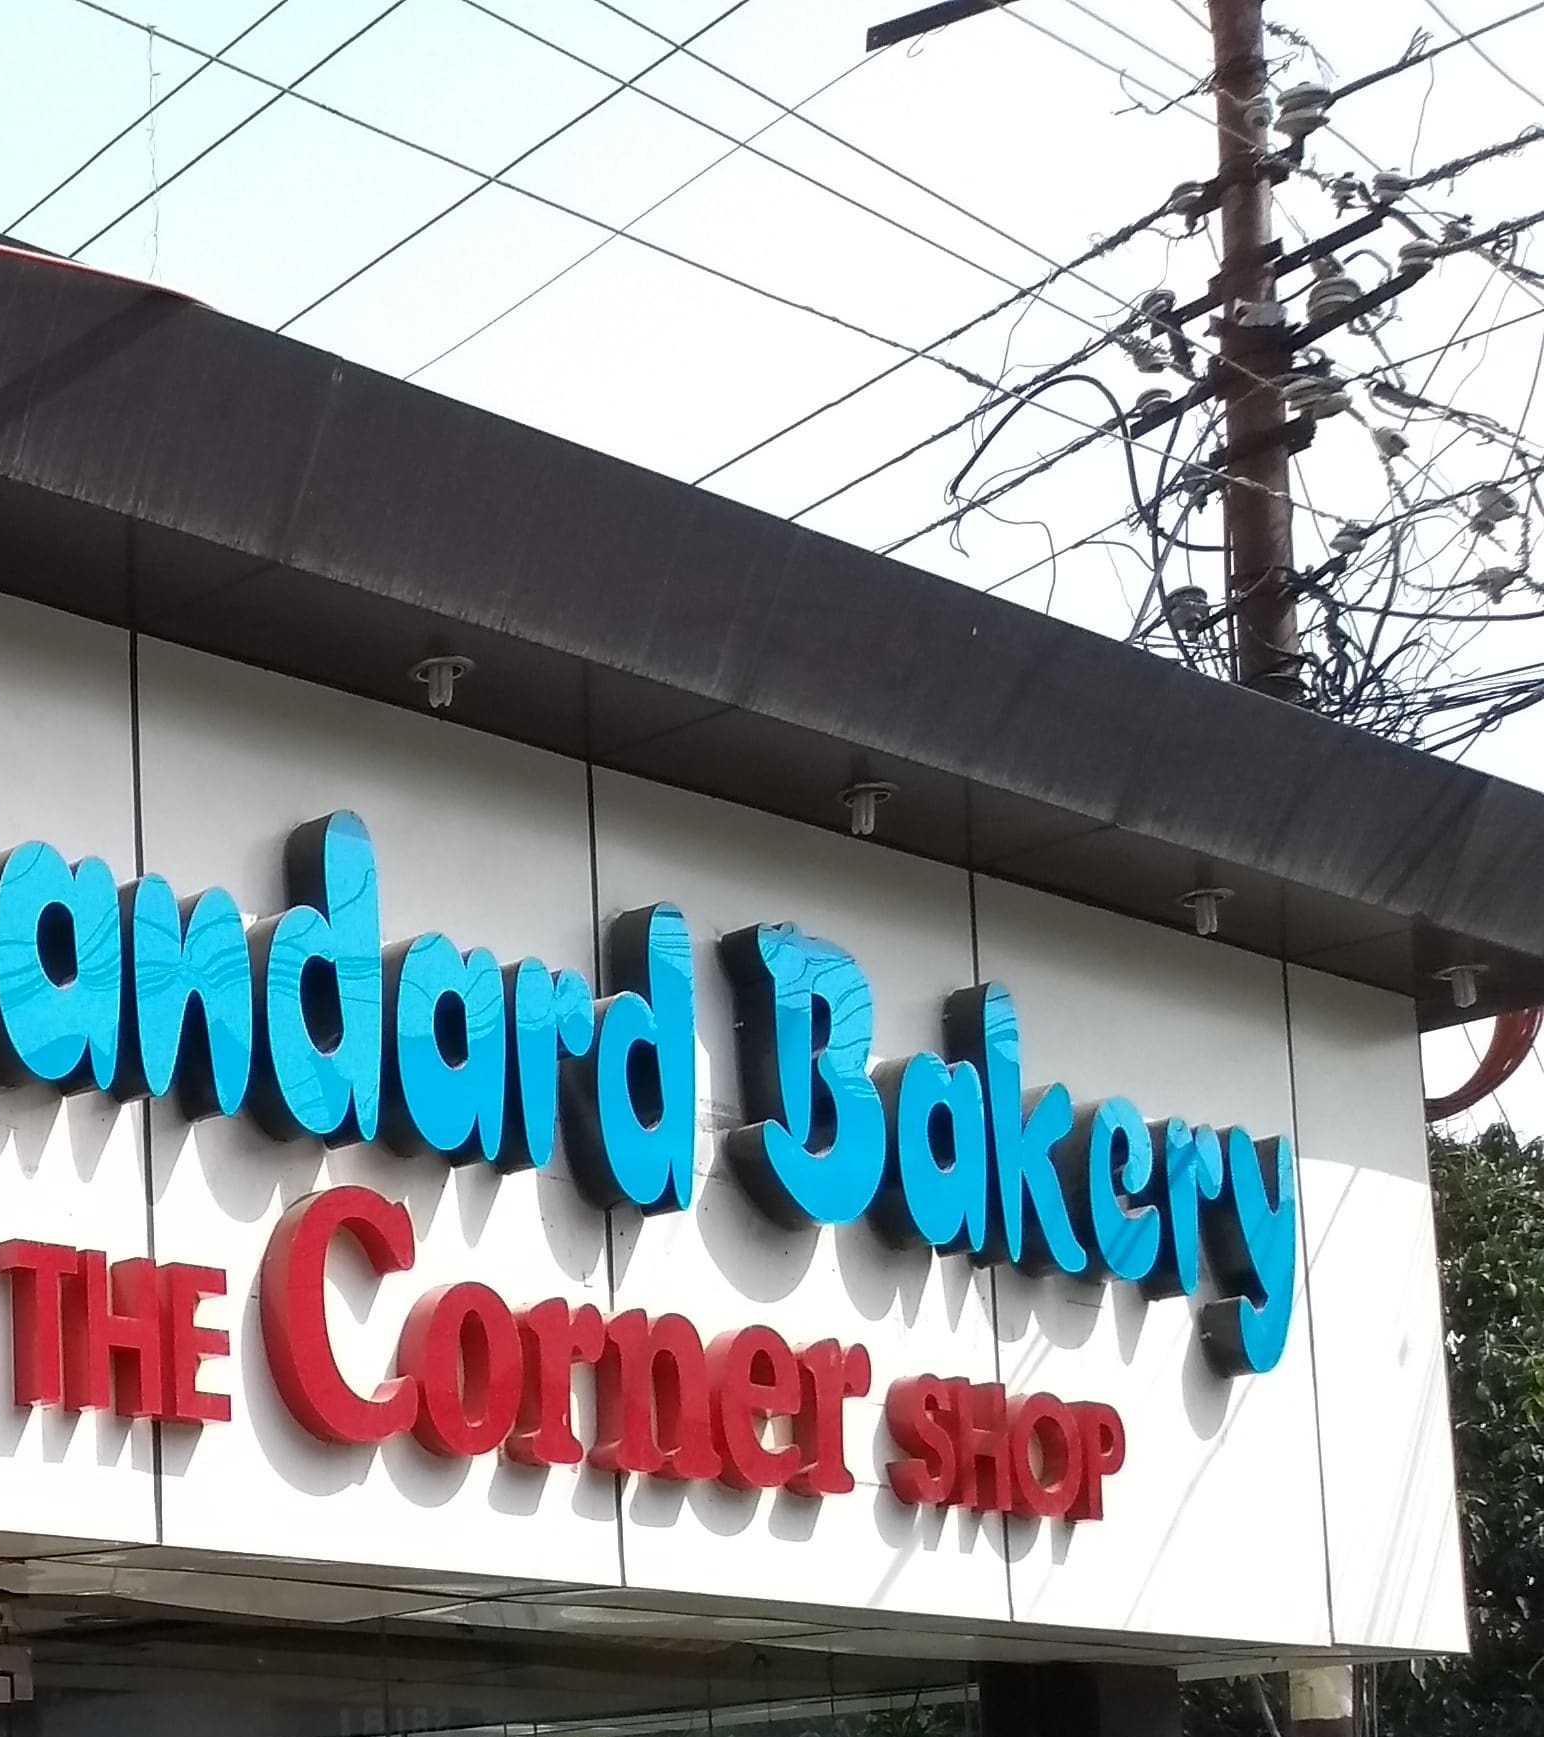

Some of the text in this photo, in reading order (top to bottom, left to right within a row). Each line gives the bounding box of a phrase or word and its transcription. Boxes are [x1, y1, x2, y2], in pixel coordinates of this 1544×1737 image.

[721, 921, 1295, 1376] Bakery
[261, 1185, 869, 1496] Corner
[886, 1374, 1126, 1523] SHOP
